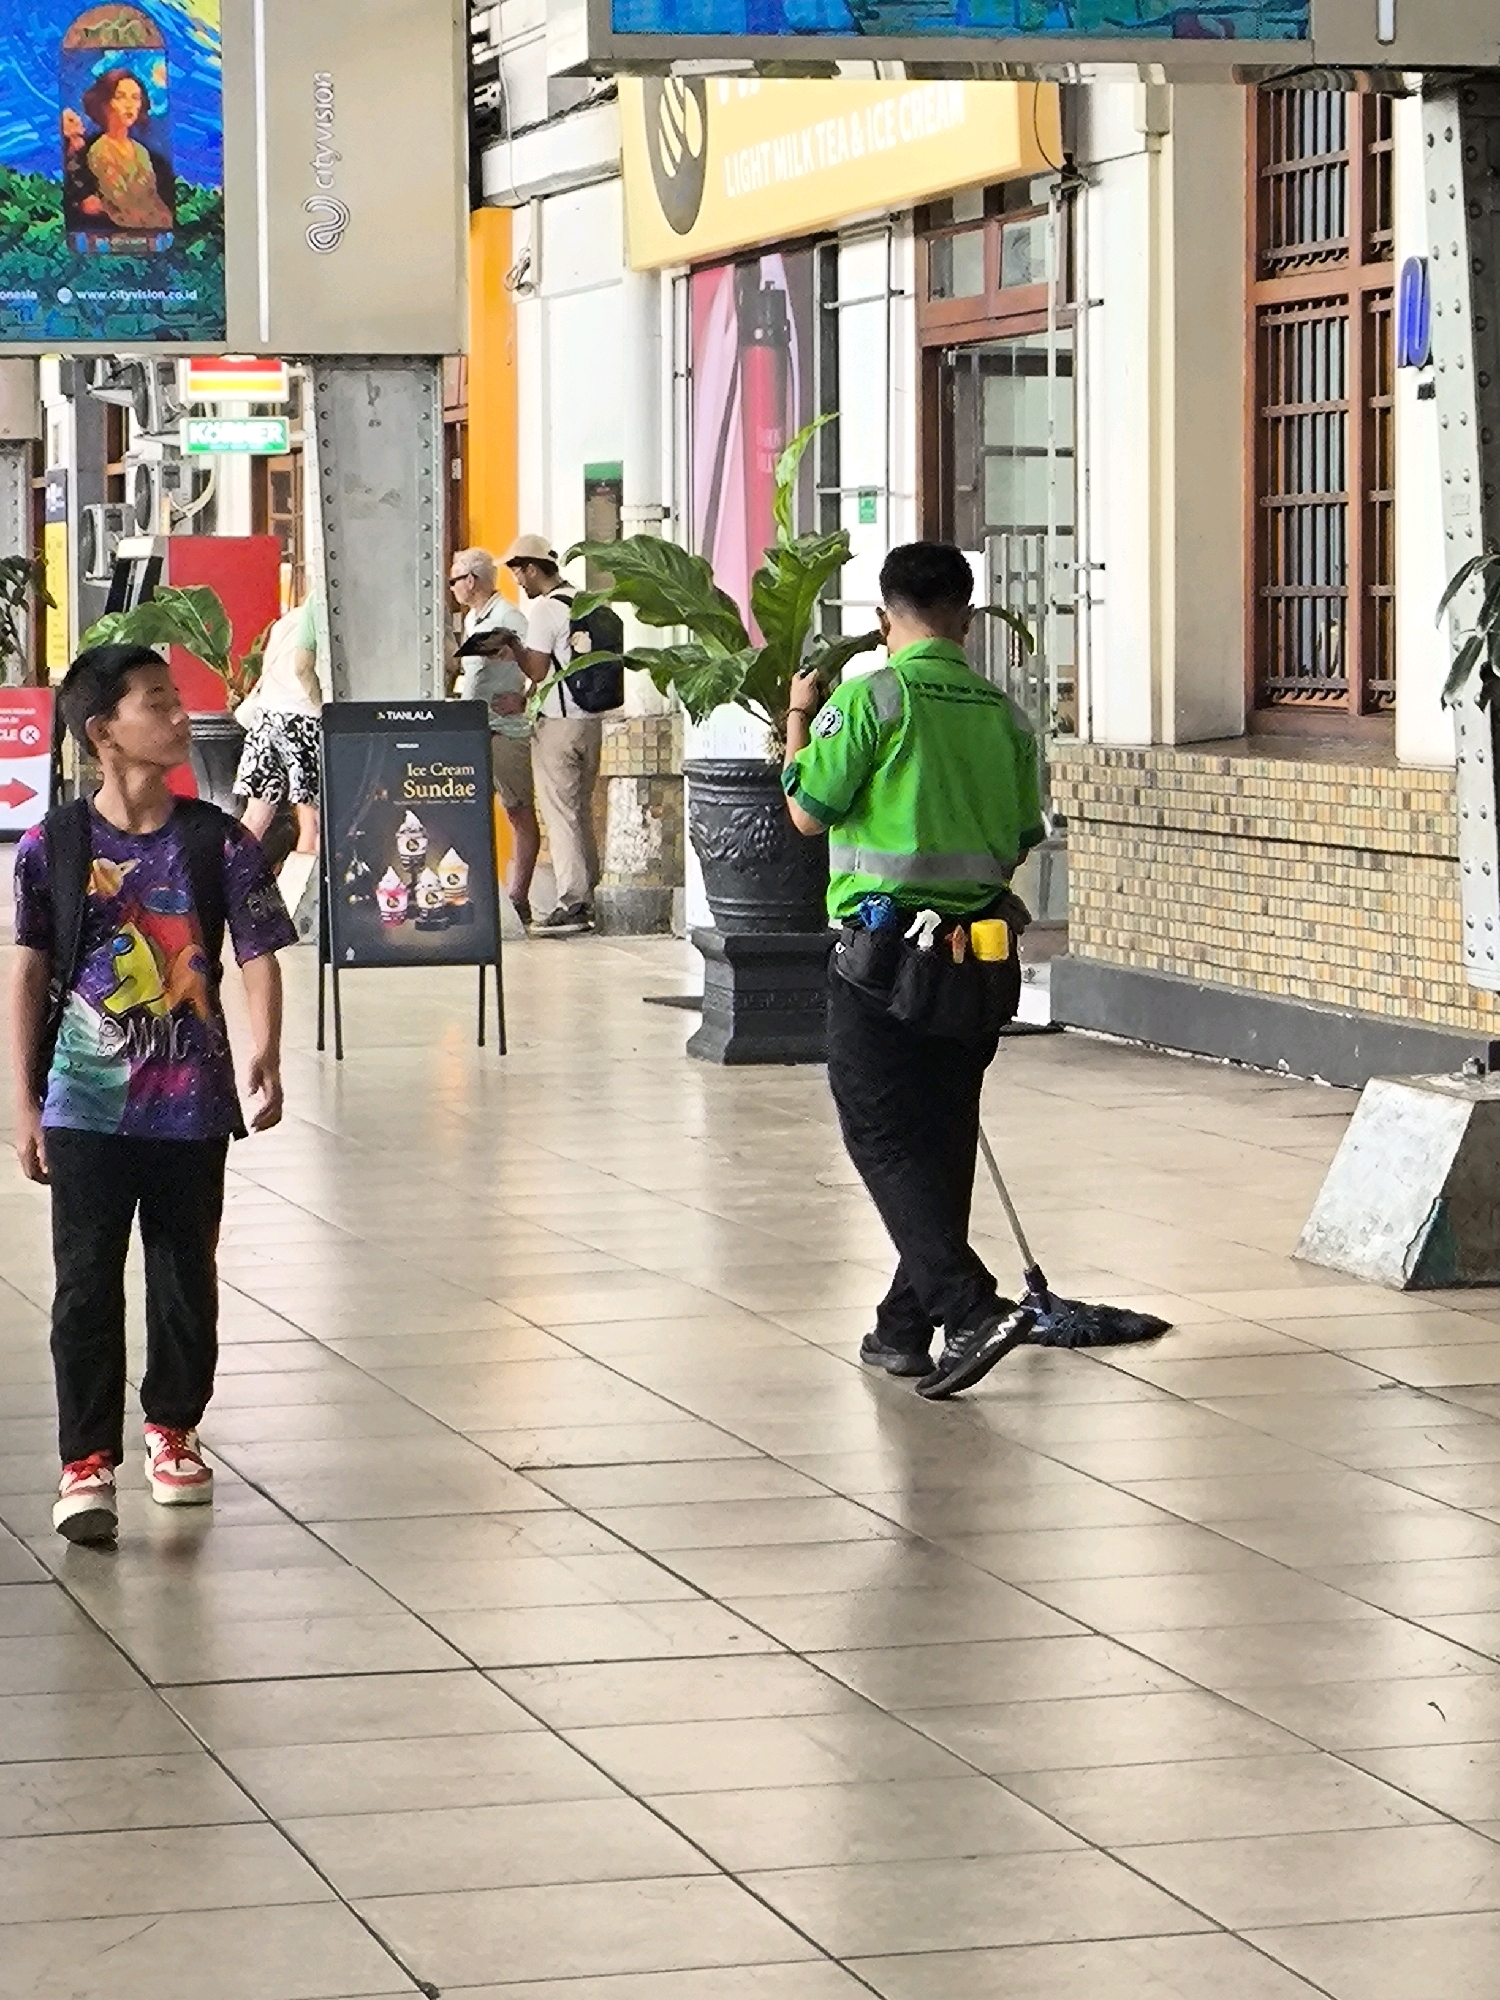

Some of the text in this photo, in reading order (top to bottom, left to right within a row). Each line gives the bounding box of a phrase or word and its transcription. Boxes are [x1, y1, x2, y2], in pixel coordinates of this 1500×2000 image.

[310, 71, 342, 189] cityvision
[723, 79, 966, 198] LIGHT MILK TEA & ICE CREAM
[76, 288, 198, 302] www.cityvision.co.id
[386, 710, 434, 720] TIANLALA
[406, 762, 476, 777] Ice Cream
[402, 777, 477, 799] Sundae
